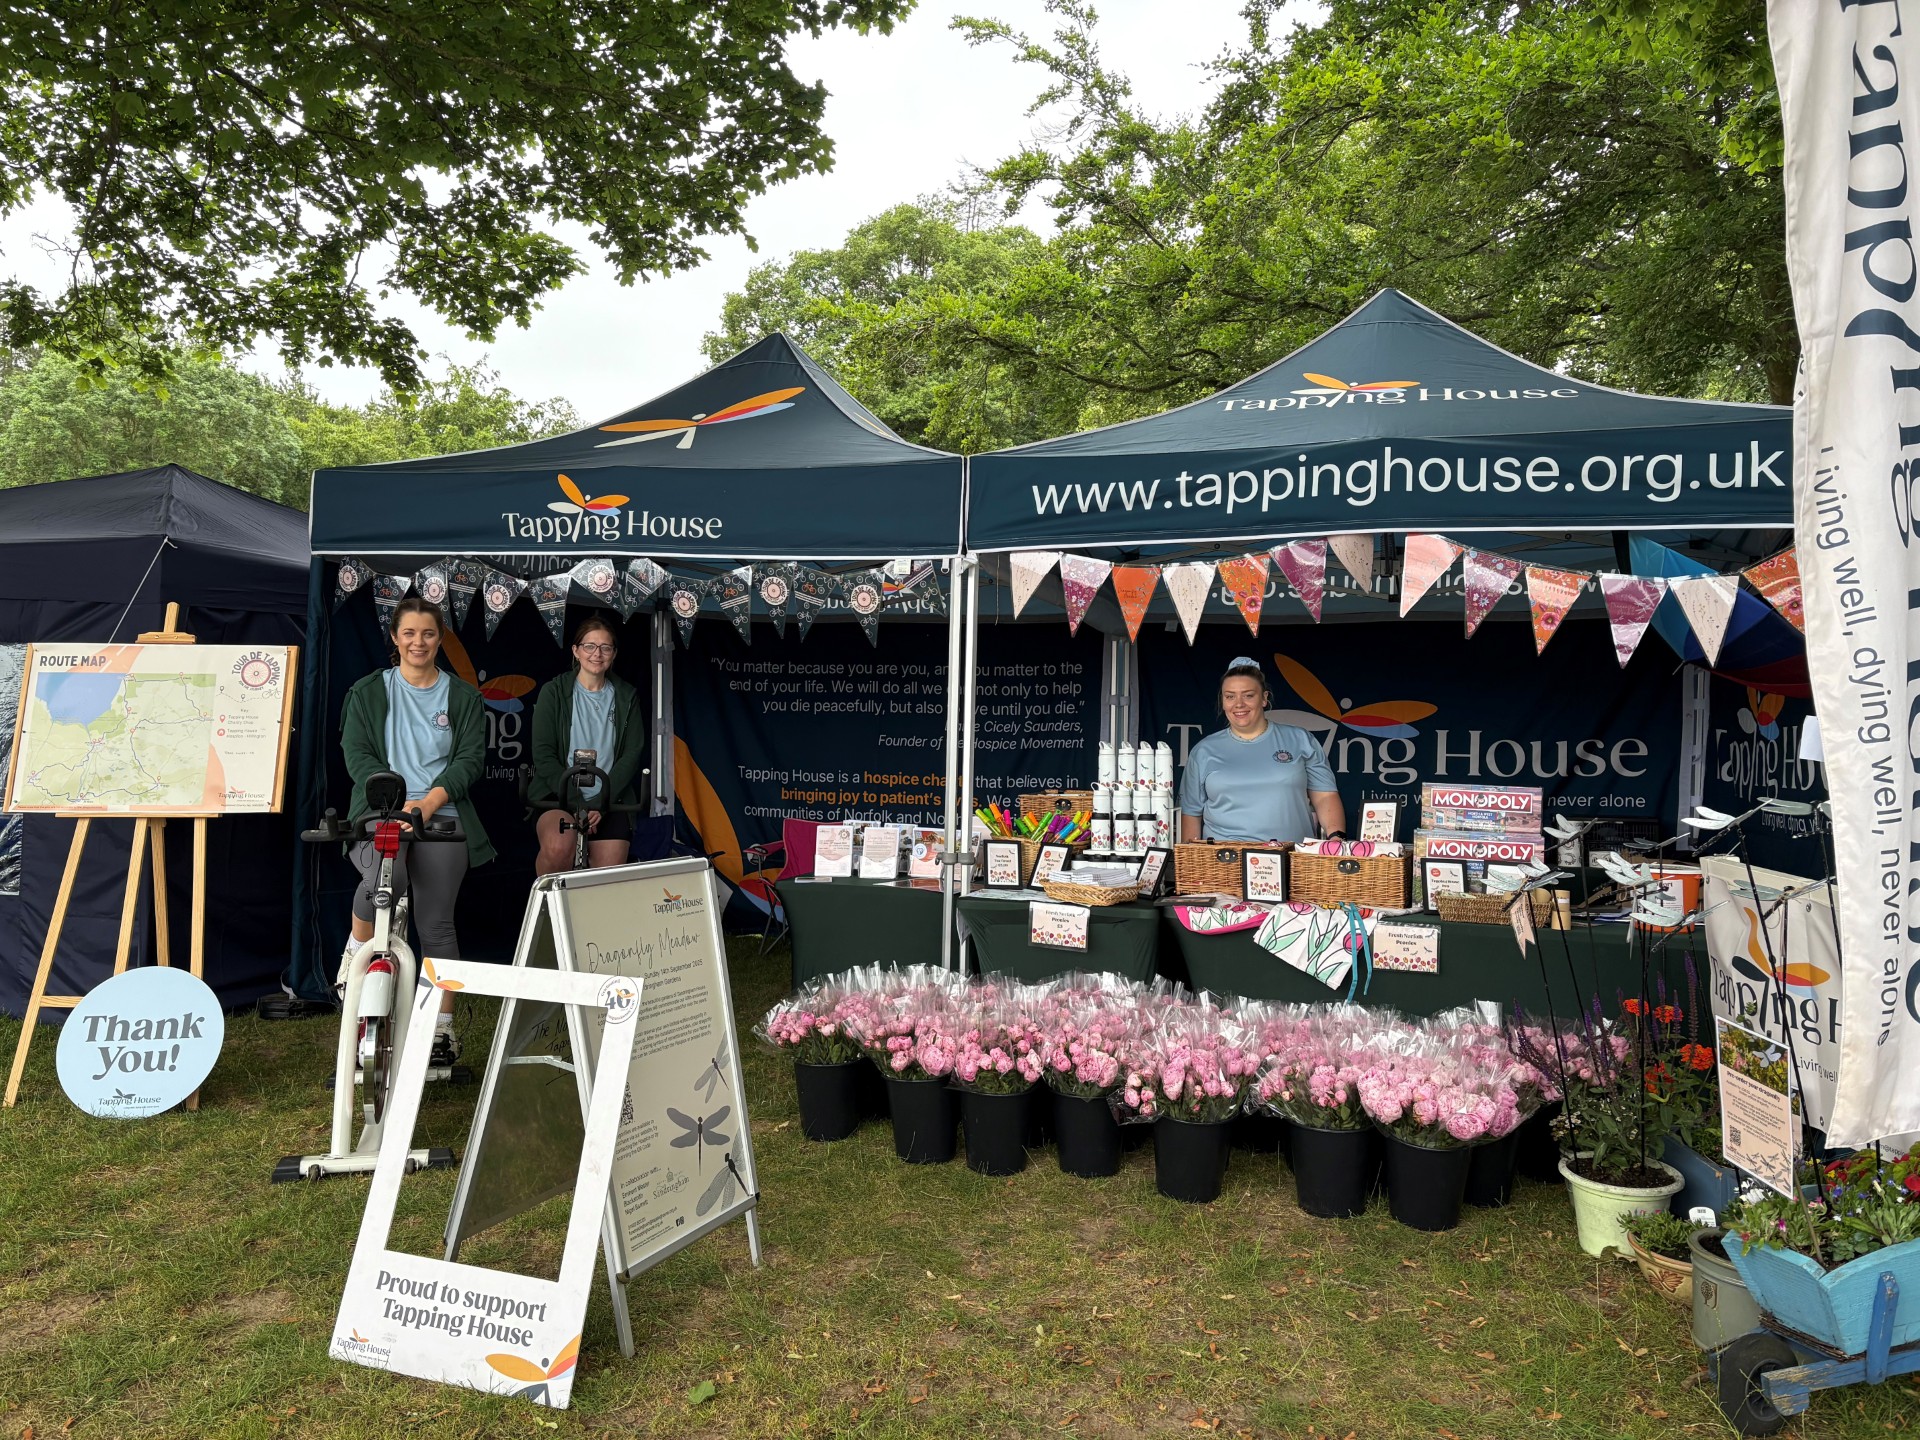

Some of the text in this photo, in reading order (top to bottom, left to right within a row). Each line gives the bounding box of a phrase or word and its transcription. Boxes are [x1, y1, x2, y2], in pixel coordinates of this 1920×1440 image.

[1219, 386, 1580, 412] Tapping House
[1032, 441, 1786, 516] www.tappinghouse.org.uk
[502, 511, 722, 543] Tapping House
[1833, 556, 1877, 636] well,
[40, 656, 106, 667] ROUTE MAP
[232, 654, 249, 675] TOUR
[250, 651, 262, 660] DE
[263, 653, 281, 686] TAPPING
[743, 661, 784, 673] matter
[788, 661, 844, 674] because
[848, 664, 873, 677] you
[876, 664, 897, 675] are
[901, 665, 929, 678] you,
[934, 665, 949, 676] an
[975, 665, 990, 676] ou
[994, 664, 1039, 677] matter
[1043, 663, 1056, 675] to
[1060, 661, 1083, 674] the
[730, 679, 750, 692] end
[755, 679, 768, 692] of
[772, 681, 801, 695] your
[805, 680, 827, 693] life.
[831, 680, 854, 693] We
[858, 680, 879, 693] will
[882, 680, 900, 694] do
[903, 681, 917, 694] all
[922, 683, 943, 694] we
[976, 684, 997, 696] not
[1001, 683, 1031, 699] only
[1035, 683, 1048, 696] to
[1052, 681, 1082, 697] help
[1848, 646, 1891, 743] dying
[763, 700, 787, 714] you
[790, 699, 810, 712] die
[814, 700, 886, 715] peacefully,
[890, 701, 911, 714] but
[915, 701, 943, 714] also
[992, 702, 1021, 716] until
[1025, 704, 1050, 719] you
[984, 720, 1084, 735] Cicely Saunders,
[878, 735, 927, 747] Founder
[930, 736, 944, 750] of
[1020, 738, 1085, 750] Movement
[1435, 729, 1649, 778] House
[486, 766, 514, 781] Living
[738, 766, 788, 784] Tapping
[793, 769, 834, 783] House
[838, 770, 848, 784] is
[852, 773, 860, 783] a
[864, 771, 920, 786] hospice
[975, 775, 1002, 789] that
[1007, 775, 1062, 789] believes
[1066, 775, 1079, 788] in
[781, 788, 836, 804] bringing
[838, 791, 859, 806] joy
[863, 791, 877, 803] to
[987, 795, 1011, 807] We
[1434, 792, 1530, 810] MONOPOLY
[1548, 794, 1594, 807] never
[1599, 794, 1646, 808] alone
[1871, 755, 1903, 834] well,
[744, 805, 823, 820] communities
[827, 807, 841, 821] of
[844, 808, 892, 823] Norfolk
[896, 811, 922, 824] and
[1430, 842, 1531, 860] MONOPOLY
[653, 899, 682, 914] Tapping
[682, 897, 703, 909] House
[1880, 848, 1900, 944] never
[586, 927, 700, 976] Dragonfly Meadow
[644, 959, 703, 980] Sunday 14th September 2025
[664, 976, 681, 986] Gardens
[605, 989, 631, 1010] 40
[1710, 955, 1821, 1045] Tapping
[83, 1012, 205, 1042] Thank
[1727, 1071, 1781, 1102] Pre-order your dragonfly
[98, 1096, 133, 1107] Tapping
[133, 1095, 161, 1104] House
[653, 1176, 690, 1199] Sandringham
[376, 1270, 547, 1322] Proud to support
[383, 1298, 533, 1347] Tapping House
[336, 1337, 392, 1357] Tapping House
